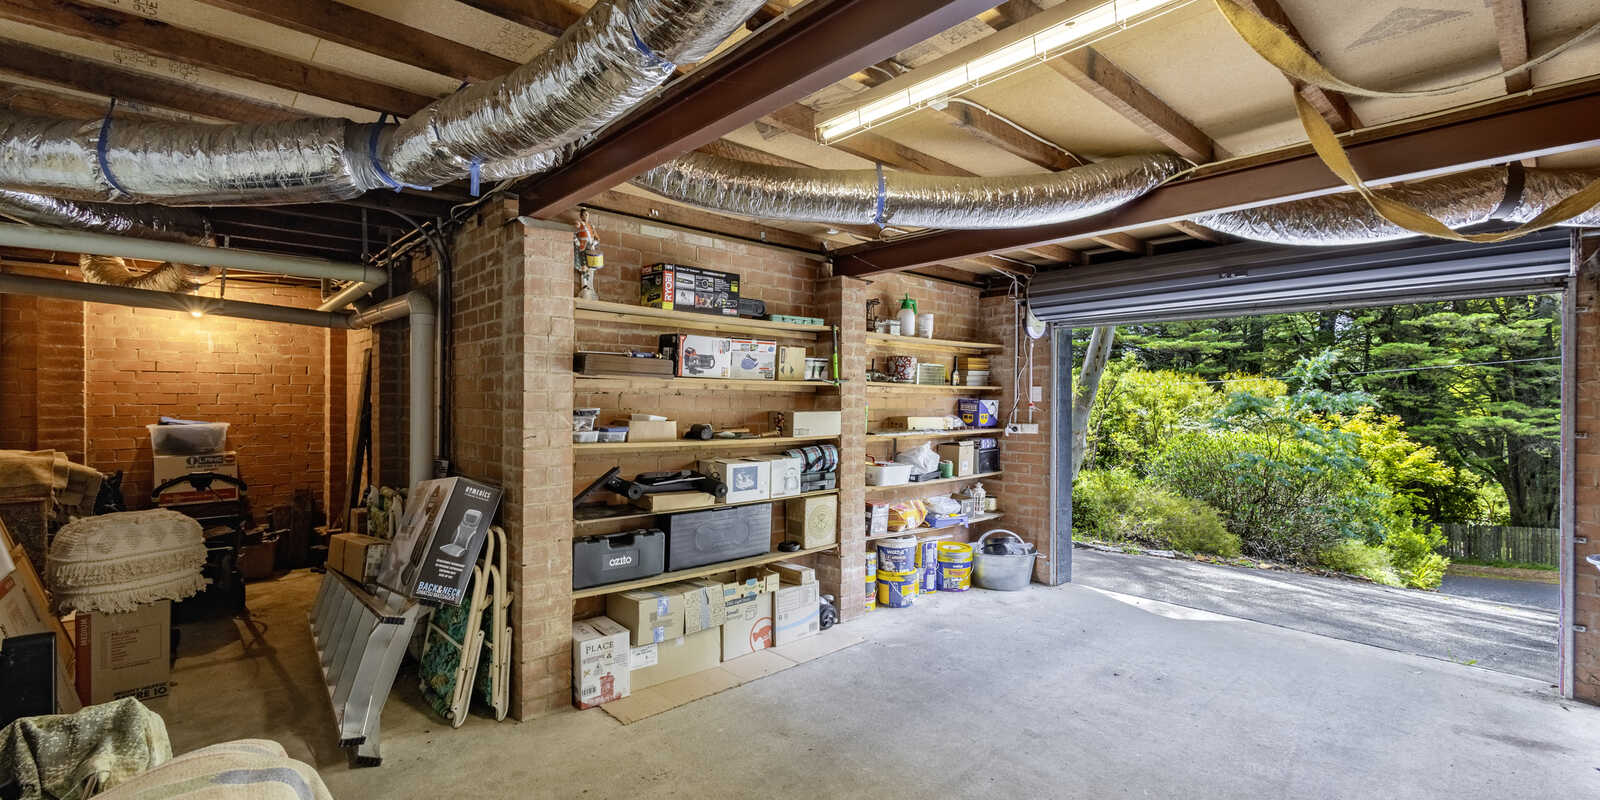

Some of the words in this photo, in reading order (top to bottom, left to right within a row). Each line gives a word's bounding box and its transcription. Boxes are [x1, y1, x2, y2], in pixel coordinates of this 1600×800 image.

[664, 272, 673, 302] RYOBI
[609, 555, 632, 566] ozito
[586, 641, 614, 655] PLACE
